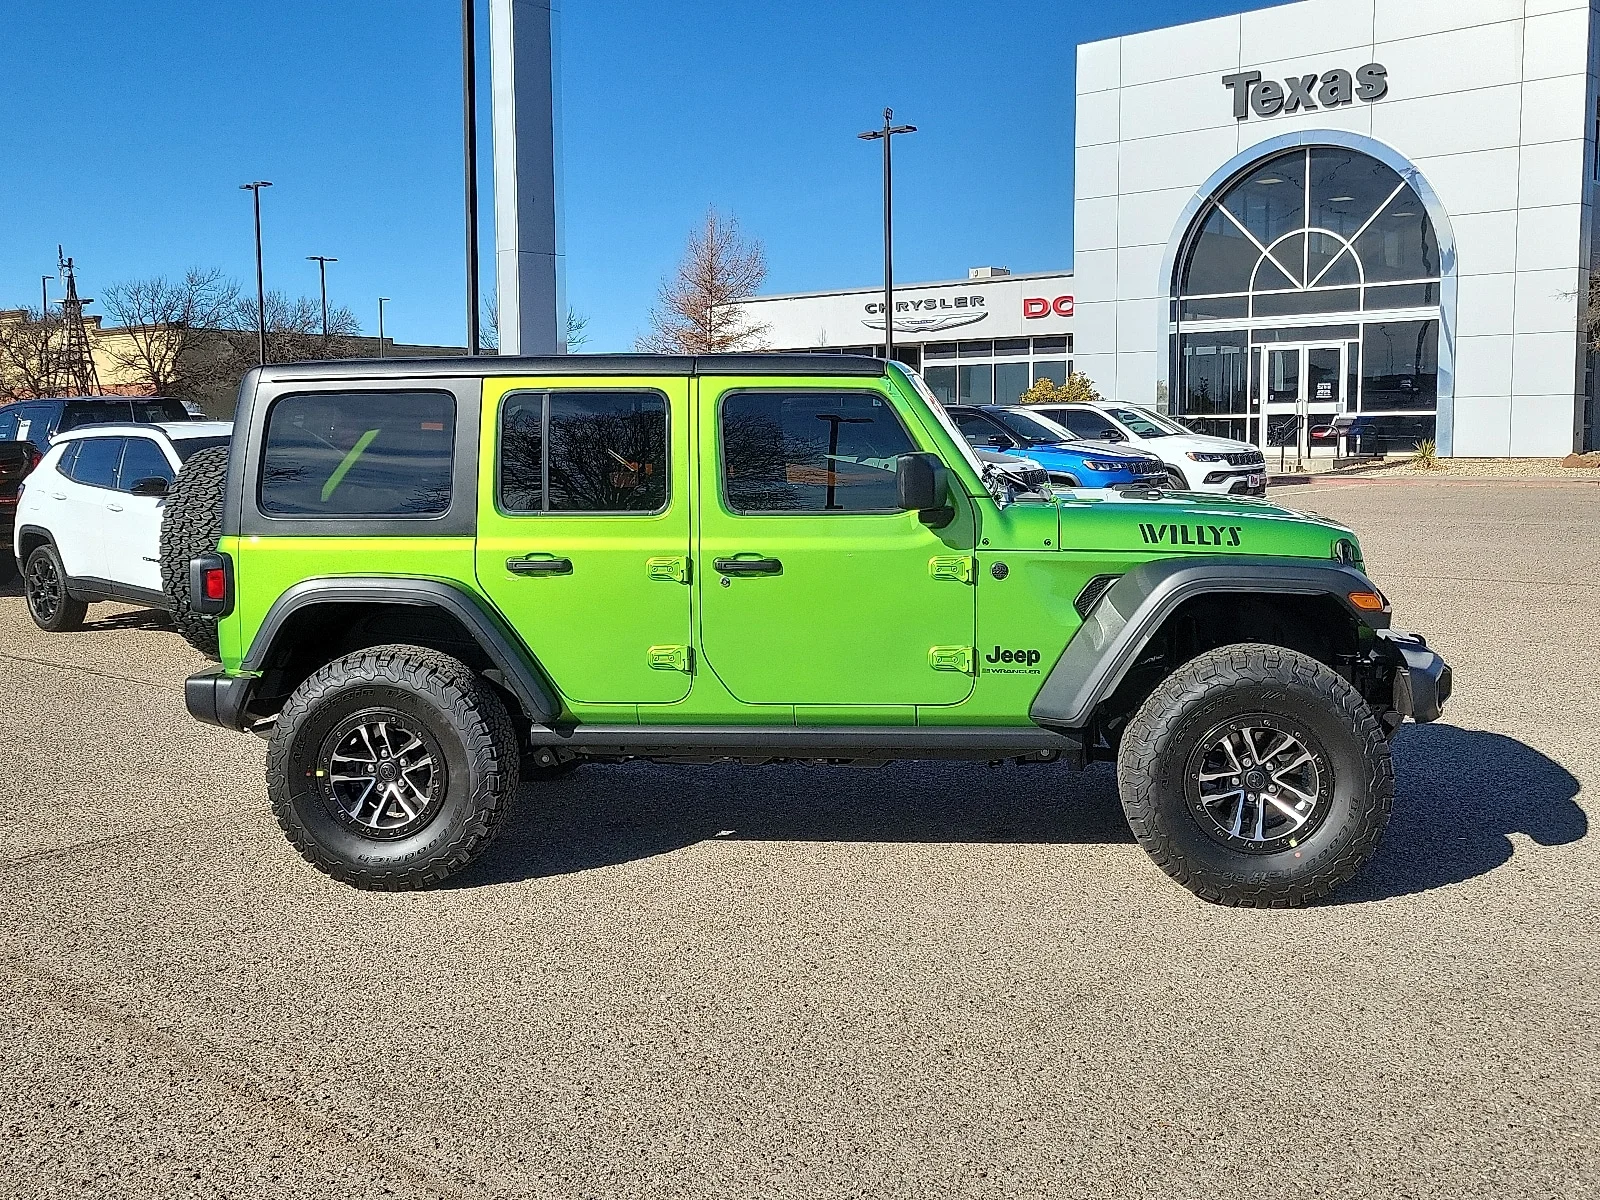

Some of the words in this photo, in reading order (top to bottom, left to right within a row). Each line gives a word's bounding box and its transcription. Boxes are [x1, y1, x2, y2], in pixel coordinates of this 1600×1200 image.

[1222, 63, 1388, 120] Texas
[1138, 523, 1242, 546] WILLYS
[986, 646, 1040, 666] Jeep
